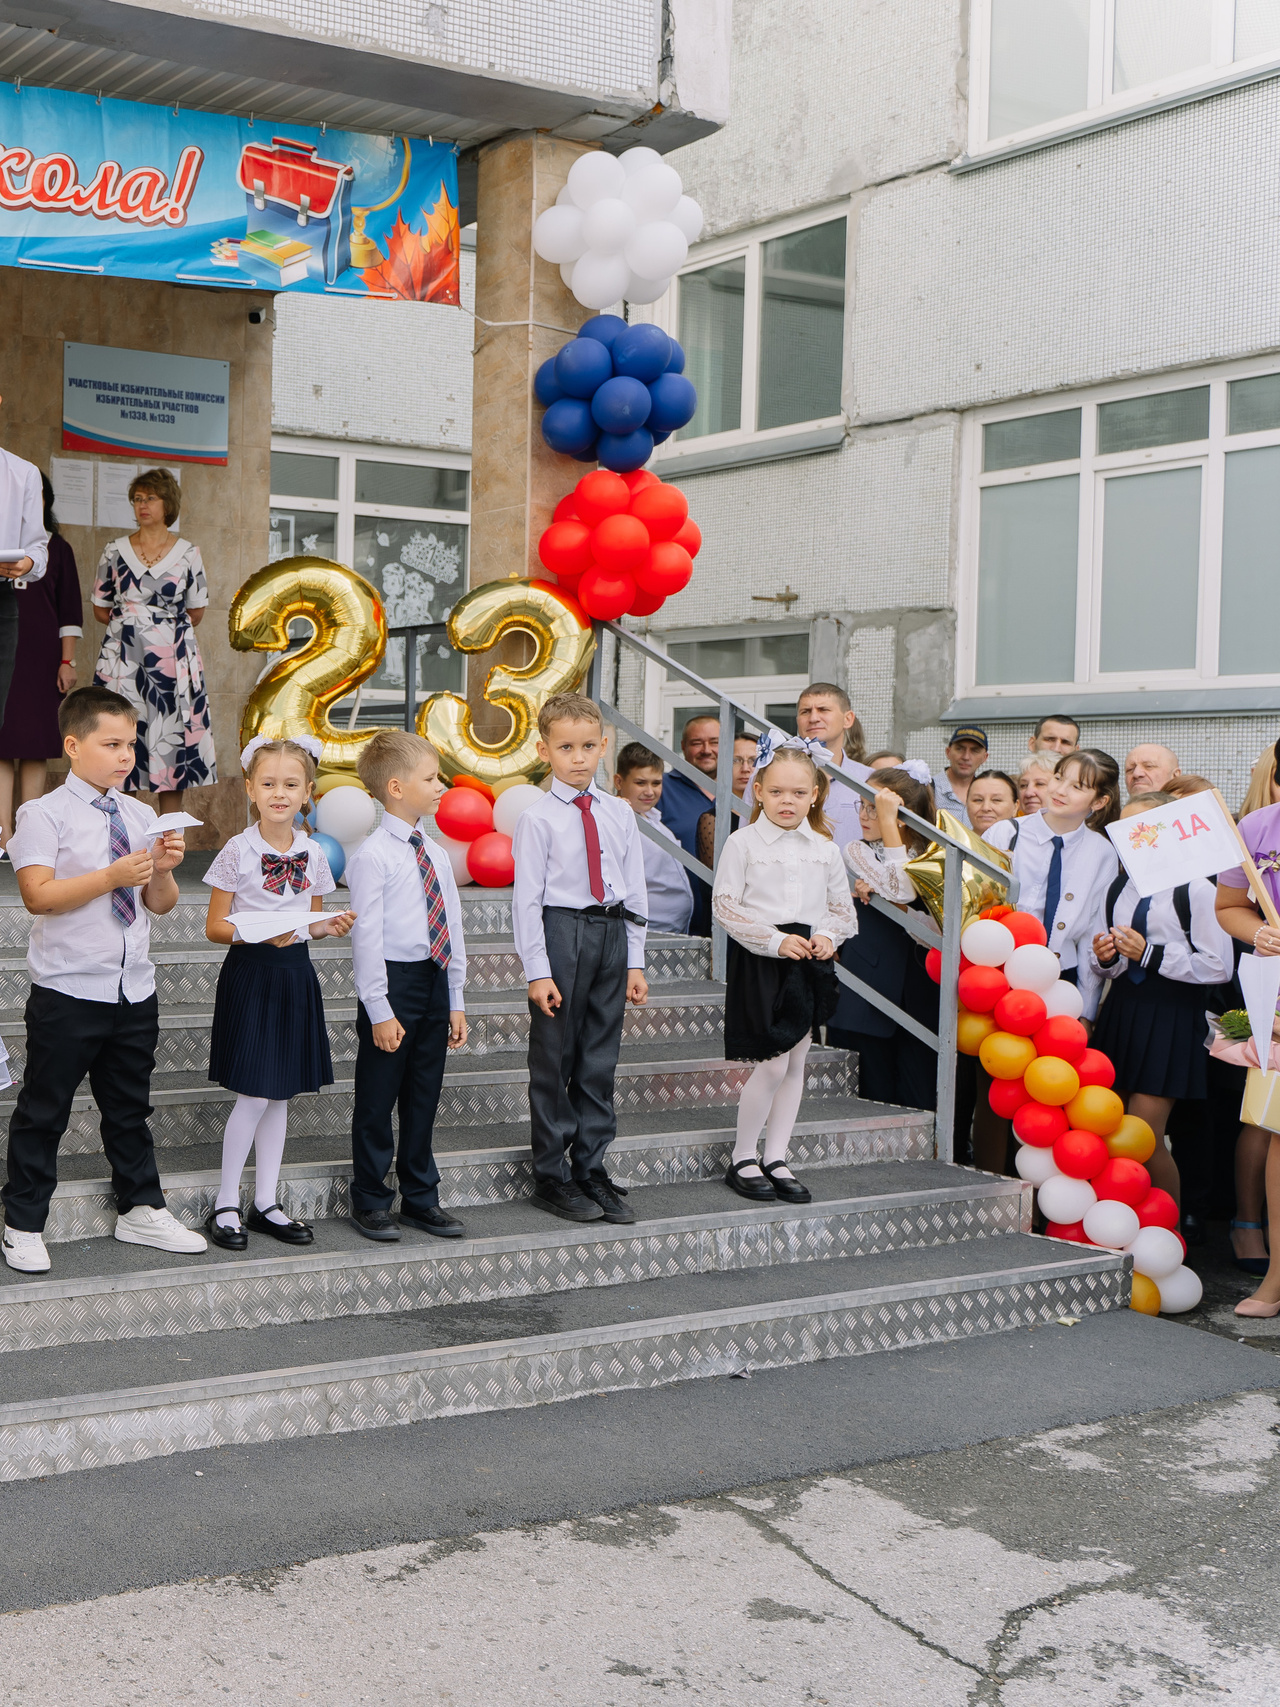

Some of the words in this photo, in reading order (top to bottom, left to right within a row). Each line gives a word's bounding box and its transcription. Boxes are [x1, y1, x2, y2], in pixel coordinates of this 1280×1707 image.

[68, 377, 119, 393] УЧАСТКОВЫЕ
[120, 383, 184, 400] ИЗБИРАТЕЛЬНЫЕ
[185, 391, 225, 404] КОМИССИИ
[95, 393, 160, 410] ИЗБИРАТЕЛЬНЫХ
[161, 401, 199, 414] УЧАСТКОВ
[120, 410, 148, 422] №1338,
[149, 413, 176, 424] №1339
